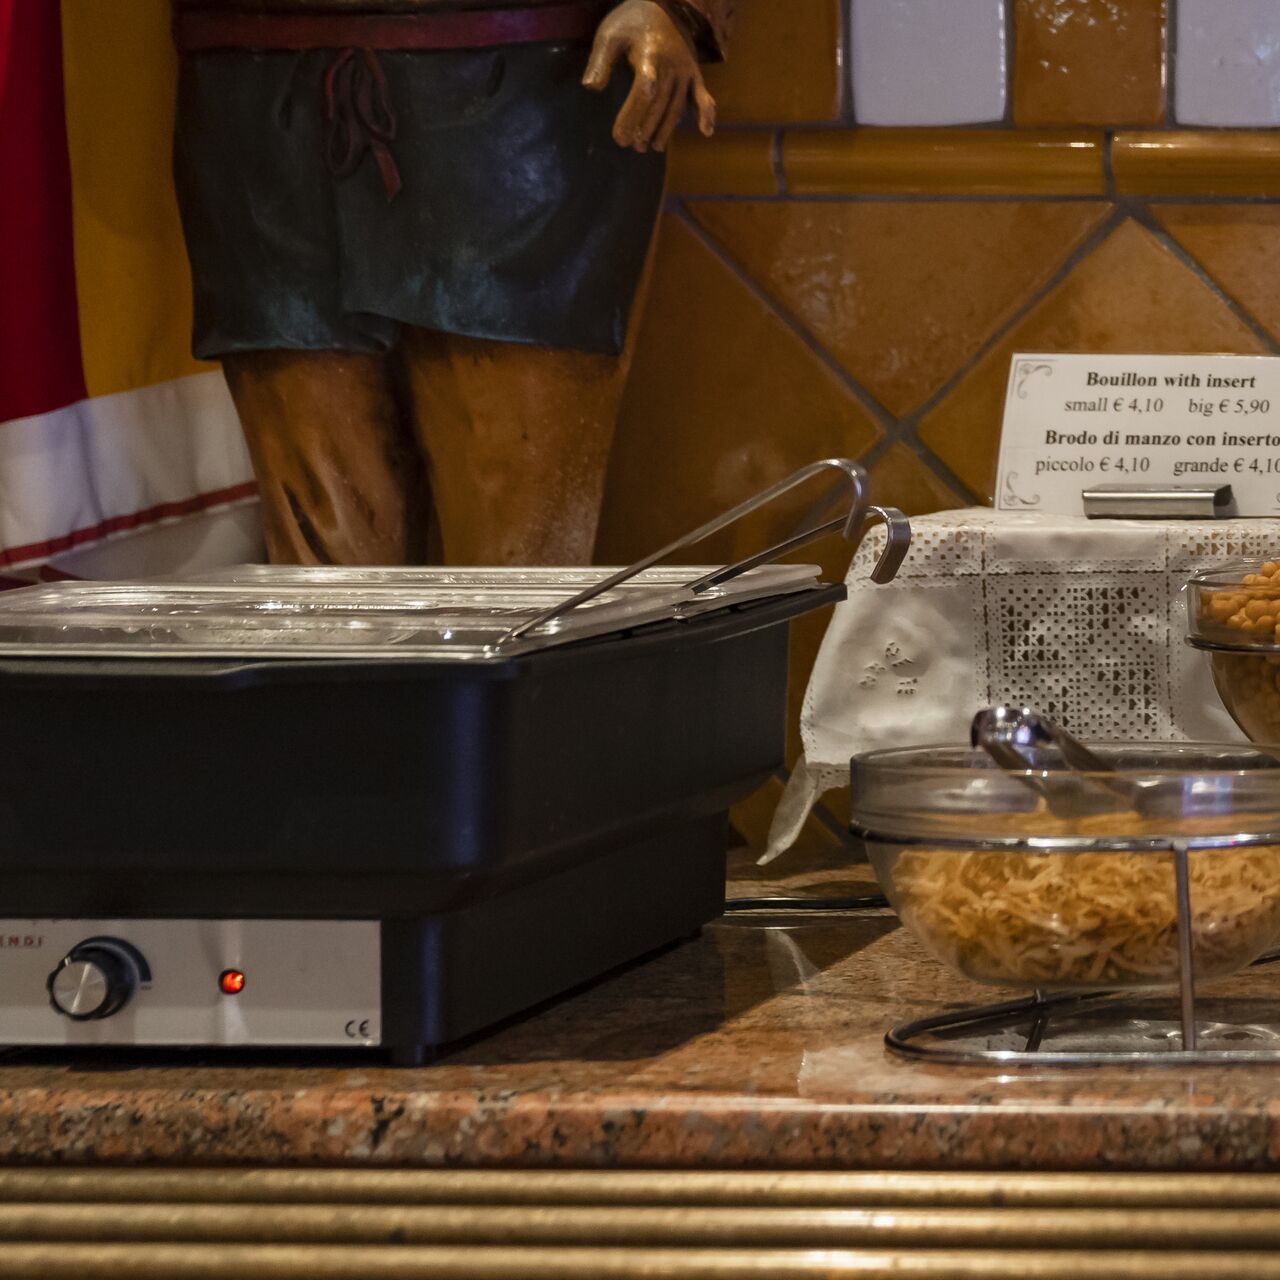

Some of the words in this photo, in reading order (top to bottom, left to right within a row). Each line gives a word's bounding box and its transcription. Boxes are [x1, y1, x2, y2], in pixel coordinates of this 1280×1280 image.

[1086, 371, 1157, 387] Bouillon
[1164, 372, 1201, 388] with
[1206, 373, 1256, 388] insert
[1064, 397, 1108, 412] small
[1112, 397, 1124, 412] €
[1127, 397, 1164, 414] 4,10
[1187, 398, 1214, 417] big
[1218, 398, 1230, 413] €
[1233, 398, 1271, 415] 5,90
[1045, 430, 1098, 446] Brodo
[1103, 430, 1120, 446] di
[1124, 434, 1181, 446] manzo
[1186, 434, 1216, 446] con
[1035, 456, 1095, 476] piccolo
[1099, 457, 1111, 472] €
[1114, 457, 1151, 474] 4,10
[1173, 457, 1229, 477] grande
[1233, 457, 1245, 473] €
